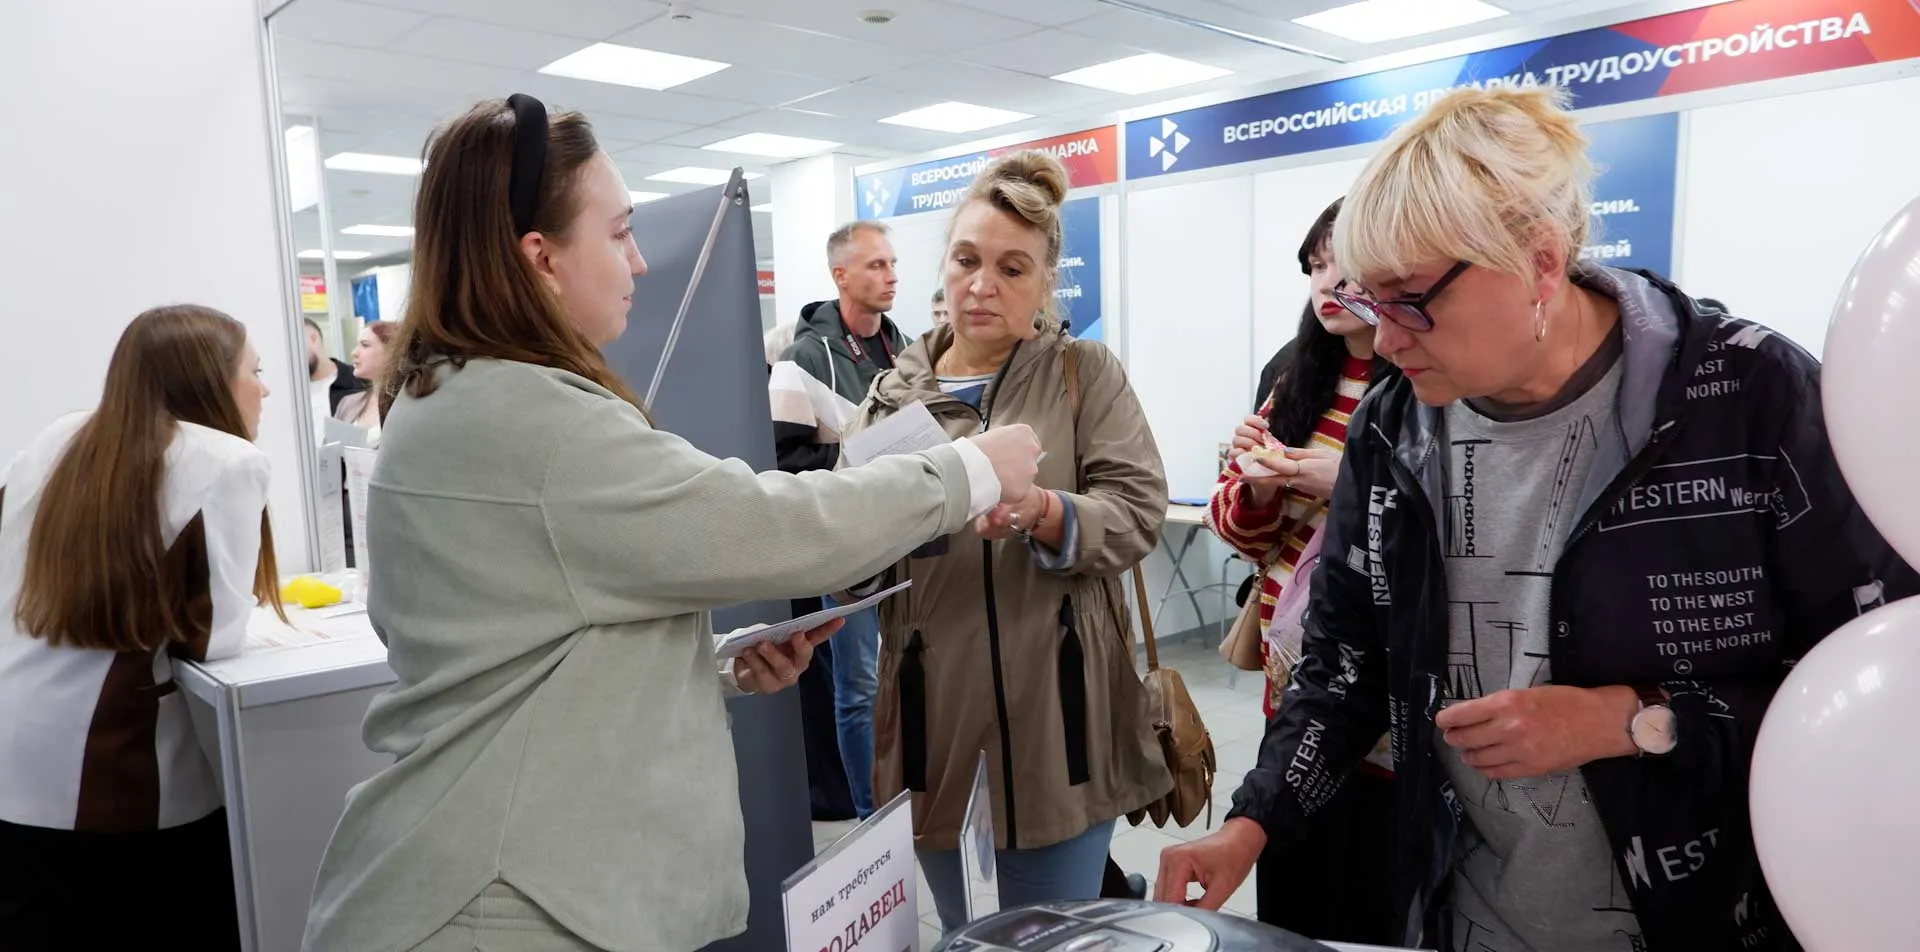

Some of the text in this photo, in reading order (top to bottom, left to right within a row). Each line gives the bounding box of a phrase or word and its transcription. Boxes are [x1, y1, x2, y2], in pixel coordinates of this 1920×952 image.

[1223, 95, 1406, 143] ВСЕРОССИЙСКАЯ
[1544, 12, 1871, 90] ТРУДОУСТРОЙСТВА
[1694, 359, 1726, 377] AST
[1686, 378, 1741, 400] NORTH
[1646, 574, 1668, 589] TO
[1649, 590, 1755, 612] TO THE WEST
[1652, 612, 1755, 634] TO THE EAST
[1656, 630, 1771, 656] TO THE NORTH
[1285, 719, 1326, 788] STERN
[810, 849, 892, 924] нам требуется
[818, 878, 907, 952] ОДАВЕЦ
